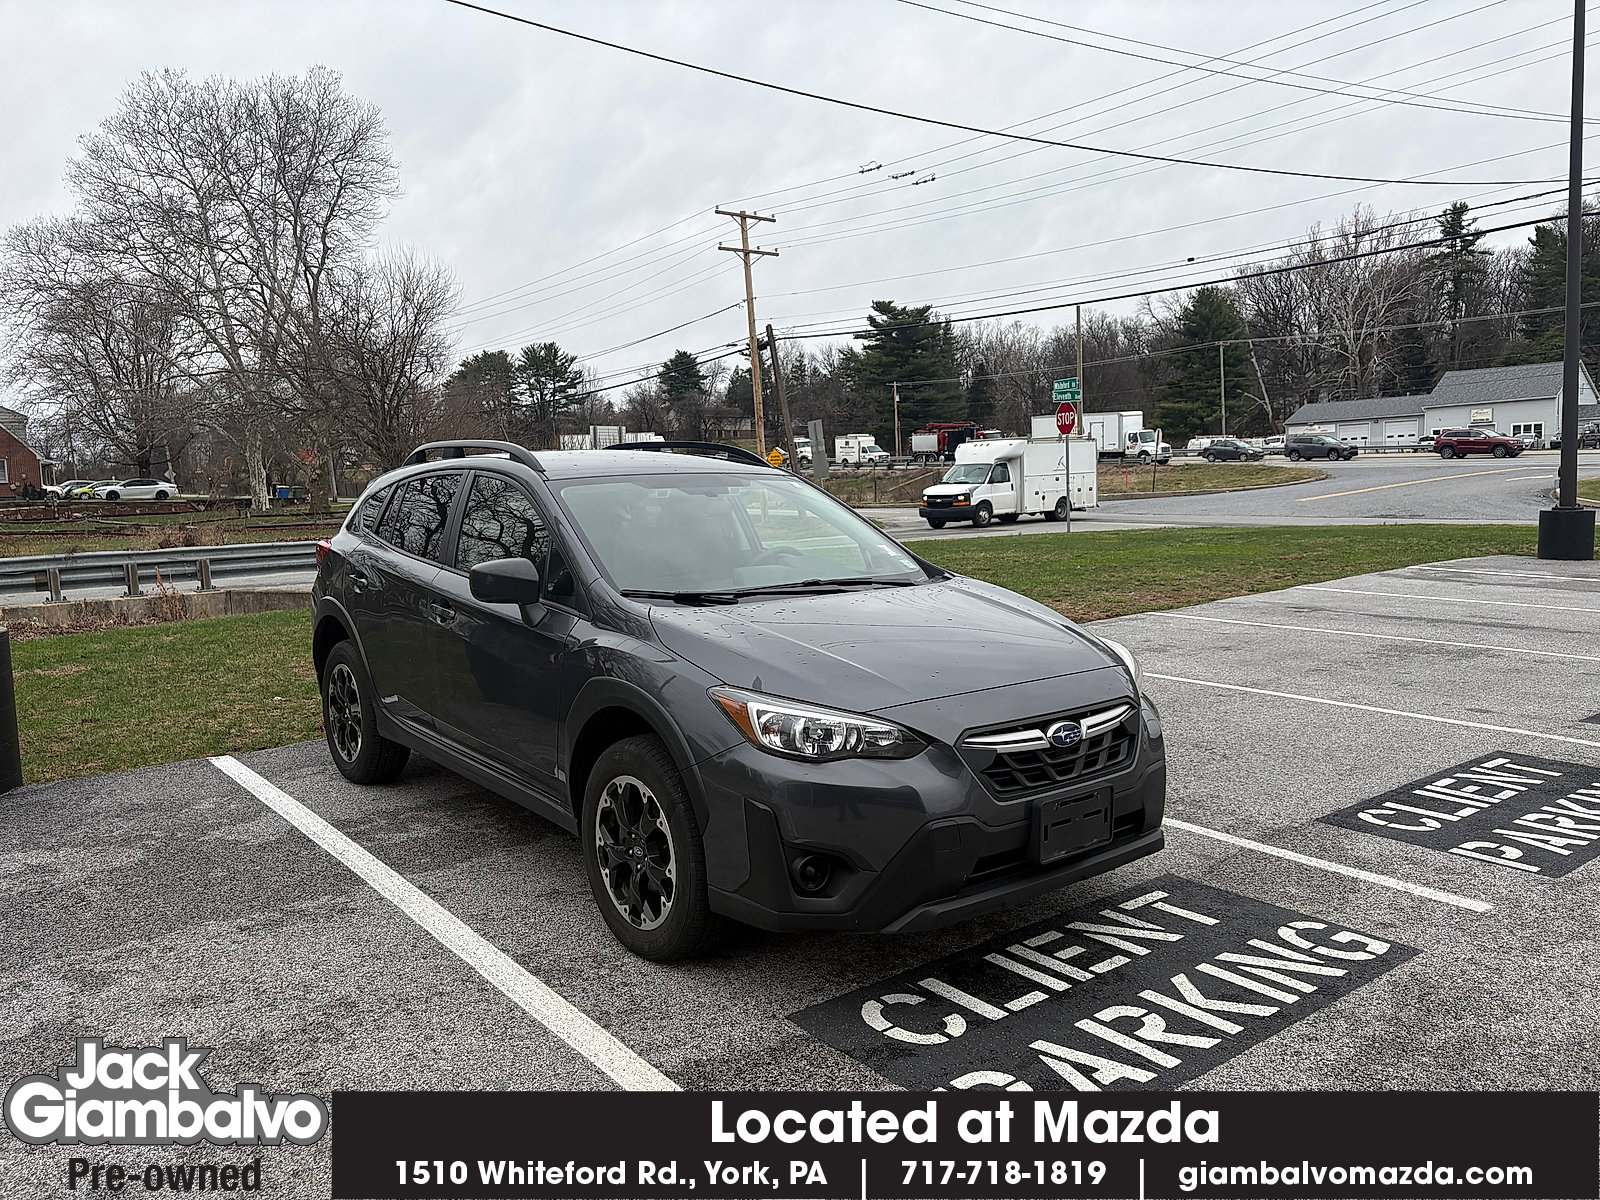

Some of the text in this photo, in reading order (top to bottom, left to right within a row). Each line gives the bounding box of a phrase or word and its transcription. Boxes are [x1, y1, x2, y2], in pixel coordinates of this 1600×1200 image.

[1057, 412, 1075, 425] STOP
[1357, 757, 1563, 831] CLIENT
[861, 890, 1220, 1045] CLIENT
